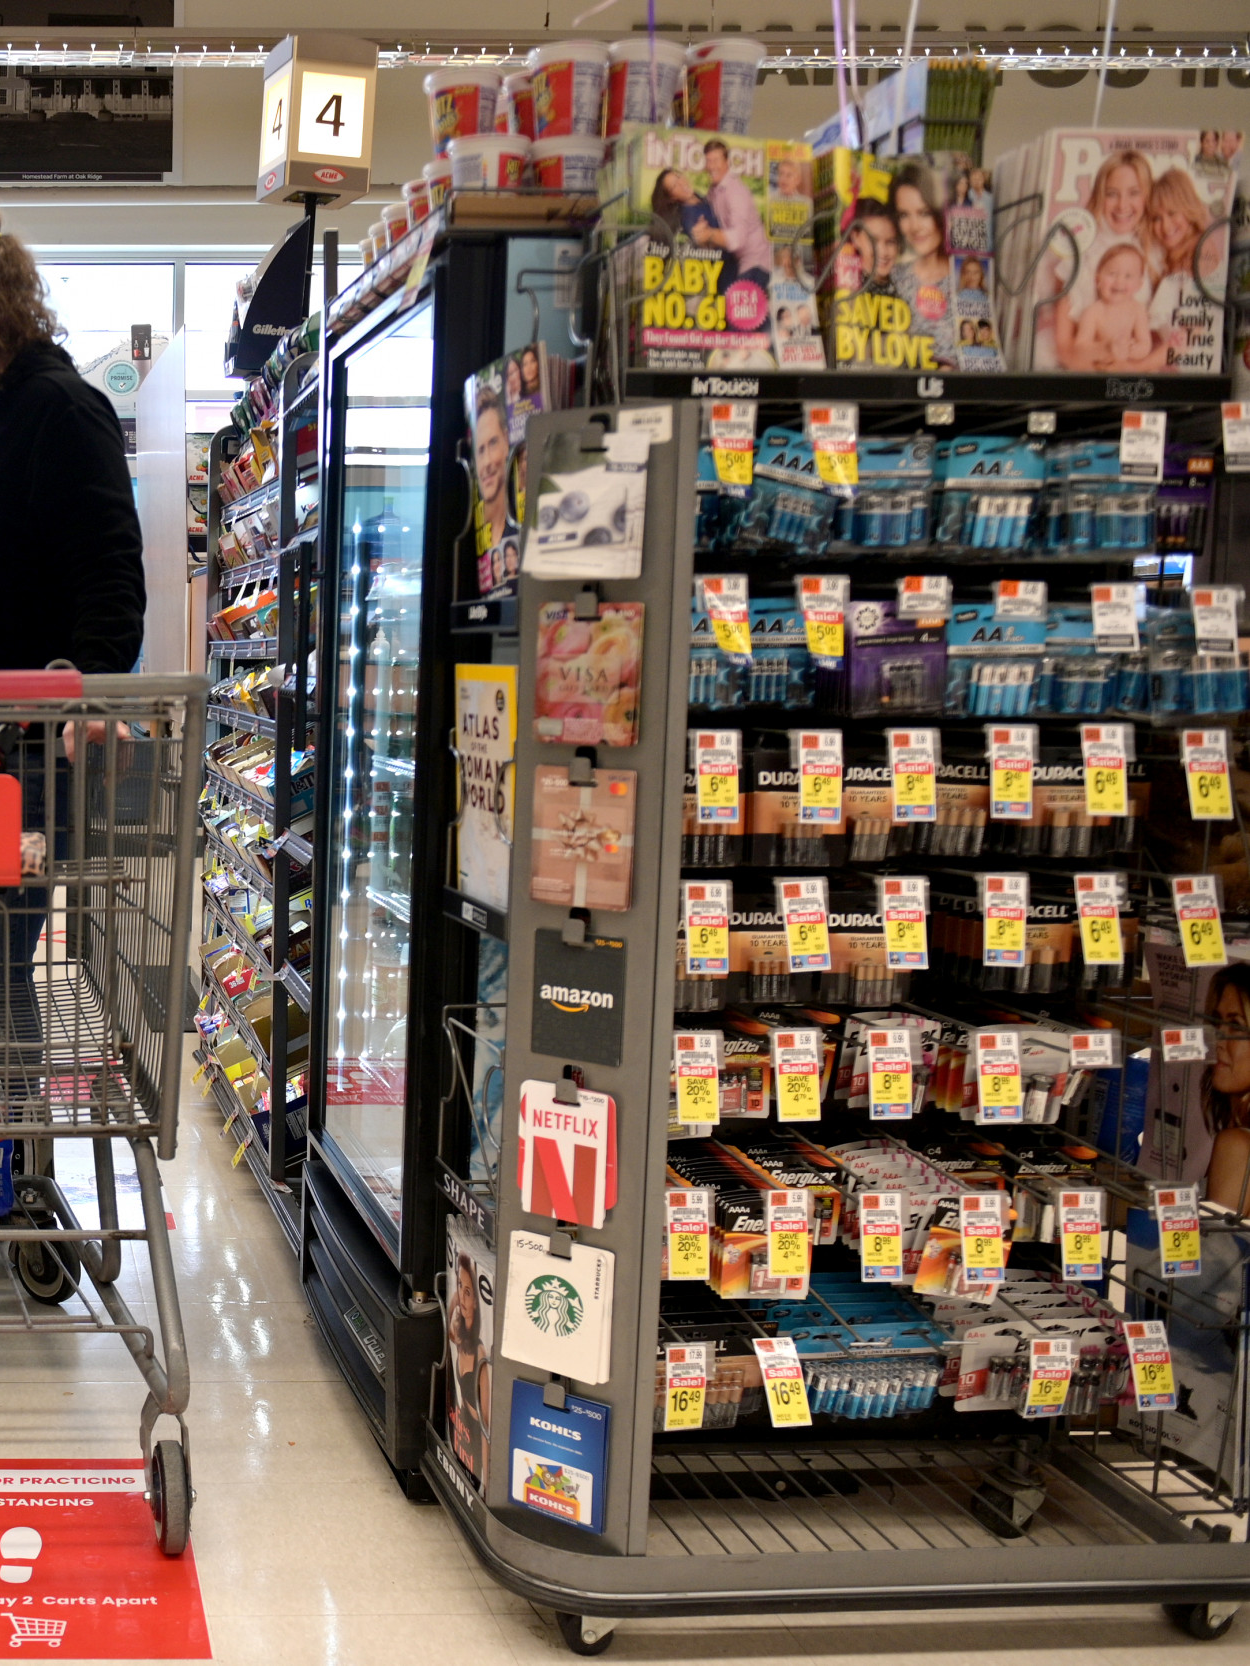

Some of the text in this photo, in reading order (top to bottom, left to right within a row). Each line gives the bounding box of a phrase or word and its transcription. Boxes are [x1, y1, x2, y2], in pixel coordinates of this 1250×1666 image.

[272, 98, 283, 140] 4
[315, 94, 345, 137] 4
[22, 173, 53, 181] Homestead
[53, 173, 68, 181] Farm
[75, 173, 87, 181] Oak
[87, 173, 103, 182] Ridge
[644, 240, 670, 257] Chip
[642, 254, 724, 295] BABY
[731, 290, 758, 304] IT'S A
[1178, 288, 1214, 308] Love,
[642, 290, 727, 331] NO. 6!
[732, 304, 758, 320] GIRL!
[835, 288, 912, 333] SAVED
[1171, 308, 1214, 330] Family
[644, 330, 666, 345] They
[1184, 329, 1214, 347] True
[836, 326, 870, 361] BY
[872, 330, 939, 370] LOVE
[1166, 350, 1214, 371] Beauty
[110, 374, 134, 382] PROMISE
[770, 451, 814, 474] AAA
[970, 460, 1002, 476] AA
[545, 610, 569, 621] VISA
[971, 626, 1002, 642] AA
[558, 666, 610, 683] VISA
[462, 714, 501, 741] ATLAS
[897, 762, 930, 774] Sale!
[1088, 757, 1121, 768] Sale!
[700, 764, 735, 775] Sale!
[804, 764, 838, 775] Sale!
[856, 795, 888, 803] YEARS
[788, 912, 823, 924] Sale!
[888, 910, 921, 922] Sale!
[1081, 906, 1114, 918] Sale!
[691, 915, 725, 927] Sale!
[758, 940, 789, 948] YEARS
[539, 983, 615, 1009] amazon
[680, 1066, 714, 1077] Sale!
[780, 1063, 814, 1075] Sale!
[873, 1061, 907, 1073] Sale!
[983, 1064, 1017, 1075] Sale!
[686, 1078, 710, 1087] SAVE
[786, 1075, 810, 1083] SAVE
[685, 1086, 711, 1096] 20%
[786, 1083, 812, 1093] 20%
[532, 1108, 599, 1140] NETFLIX
[770, 1168, 837, 1188] Energizer
[443, 1172, 486, 1230] SHAPE
[673, 1222, 705, 1233] Sale!
[771, 1221, 805, 1232] Sale!
[865, 1224, 898, 1235] Sale!
[964, 1226, 998, 1237] Sale!
[1066, 1222, 1099, 1233] Sale!
[1165, 1220, 1198, 1231] Sale!
[678, 1234, 700, 1242] SAVE
[778, 1232, 800, 1241] SAVE
[677, 1241, 702, 1252] 20%
[777, 1240, 801, 1250] 20%
[594, 1258, 603, 1301] STARBUCKS
[1136, 1352, 1167, 1364] Sale!
[767, 1367, 798, 1379] Sale!
[1036, 1370, 1067, 1380] Sale!
[671, 1377, 703, 1388] Sale!
[530, 1416, 582, 1441] KOHL'S
[19, 1475, 136, 1486] PRACTICING
[436, 1445, 475, 1509] EBONY
[529, 1492, 575, 1515] KOHL'S
[22, 1595, 34, 1606] 2
[42, 1595, 96, 1606] Carts
[101, 1594, 158, 1608] Apart
